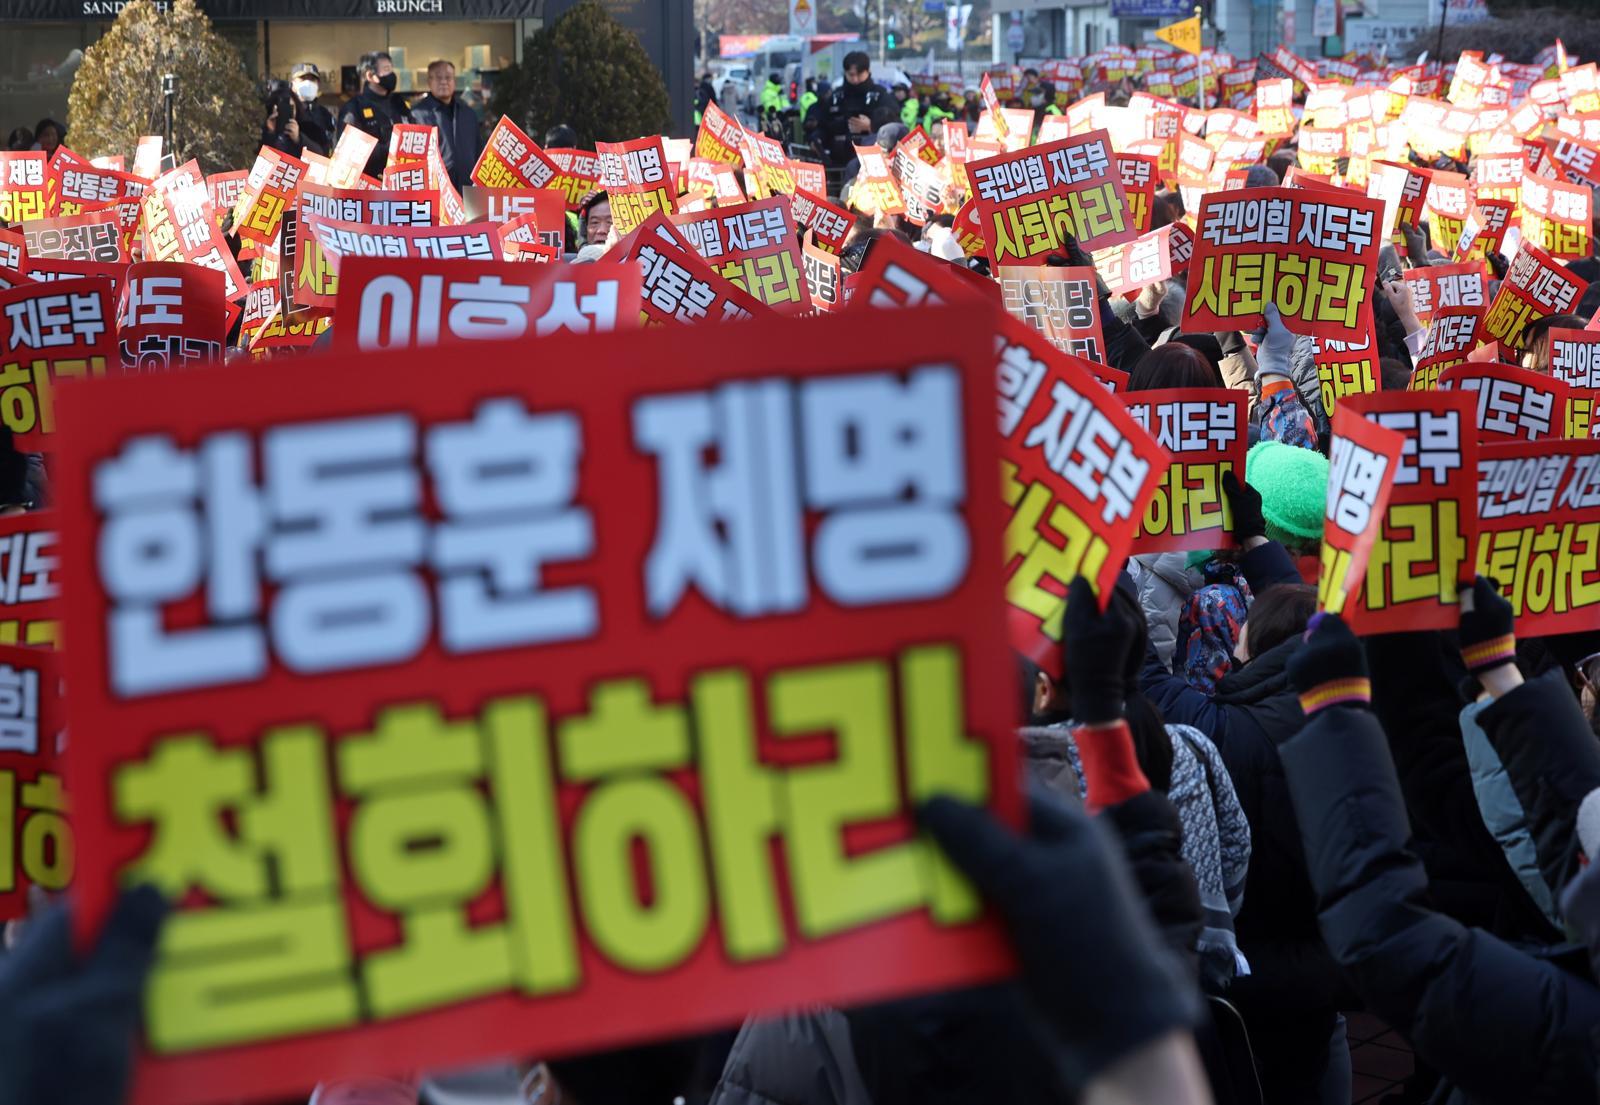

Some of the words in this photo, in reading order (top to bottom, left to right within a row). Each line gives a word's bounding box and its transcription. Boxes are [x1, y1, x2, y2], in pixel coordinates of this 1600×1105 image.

[83, 1, 168, 15] SANDH
[377, 0, 443, 13] BRUNCH
[399, 132, 428, 155] 제명
[491, 125, 528, 168] 한동훈
[518, 153, 555, 188] 제명
[623, 147, 664, 186] 제명
[1553, 138, 1598, 174] 나도
[8, 159, 44, 186] 제명
[61, 170, 120, 201] 한동훈
[974, 155, 1050, 204] 국민의힘
[1047, 140, 1110, 187] 지도부
[723, 207, 788, 252] 지도부
[809, 206, 849, 241] 지도부
[992, 182, 1127, 263] 사퇴하라
[1202, 199, 1293, 247] 국민의힘
[1297, 202, 1375, 255] 지도부
[635, 244, 717, 325] 한동훈
[1190, 253, 1367, 328] 사퇴하라
[1437, 272, 1484, 308] 제명
[1528, 265, 1579, 314] 지도부
[4, 291, 106, 352] 지도부
[1437, 315, 1478, 353] 지도부
[1024, 378, 1151, 525] 지도부
[1156, 402, 1237, 453] 지도부
[1132, 462, 1235, 539] 하라
[1477, 453, 1571, 520] 국민의힘
[92, 396, 600, 700] 한동훈
[630, 363, 973, 619] 제명
[112, 642, 989, 1055] 철회하라
